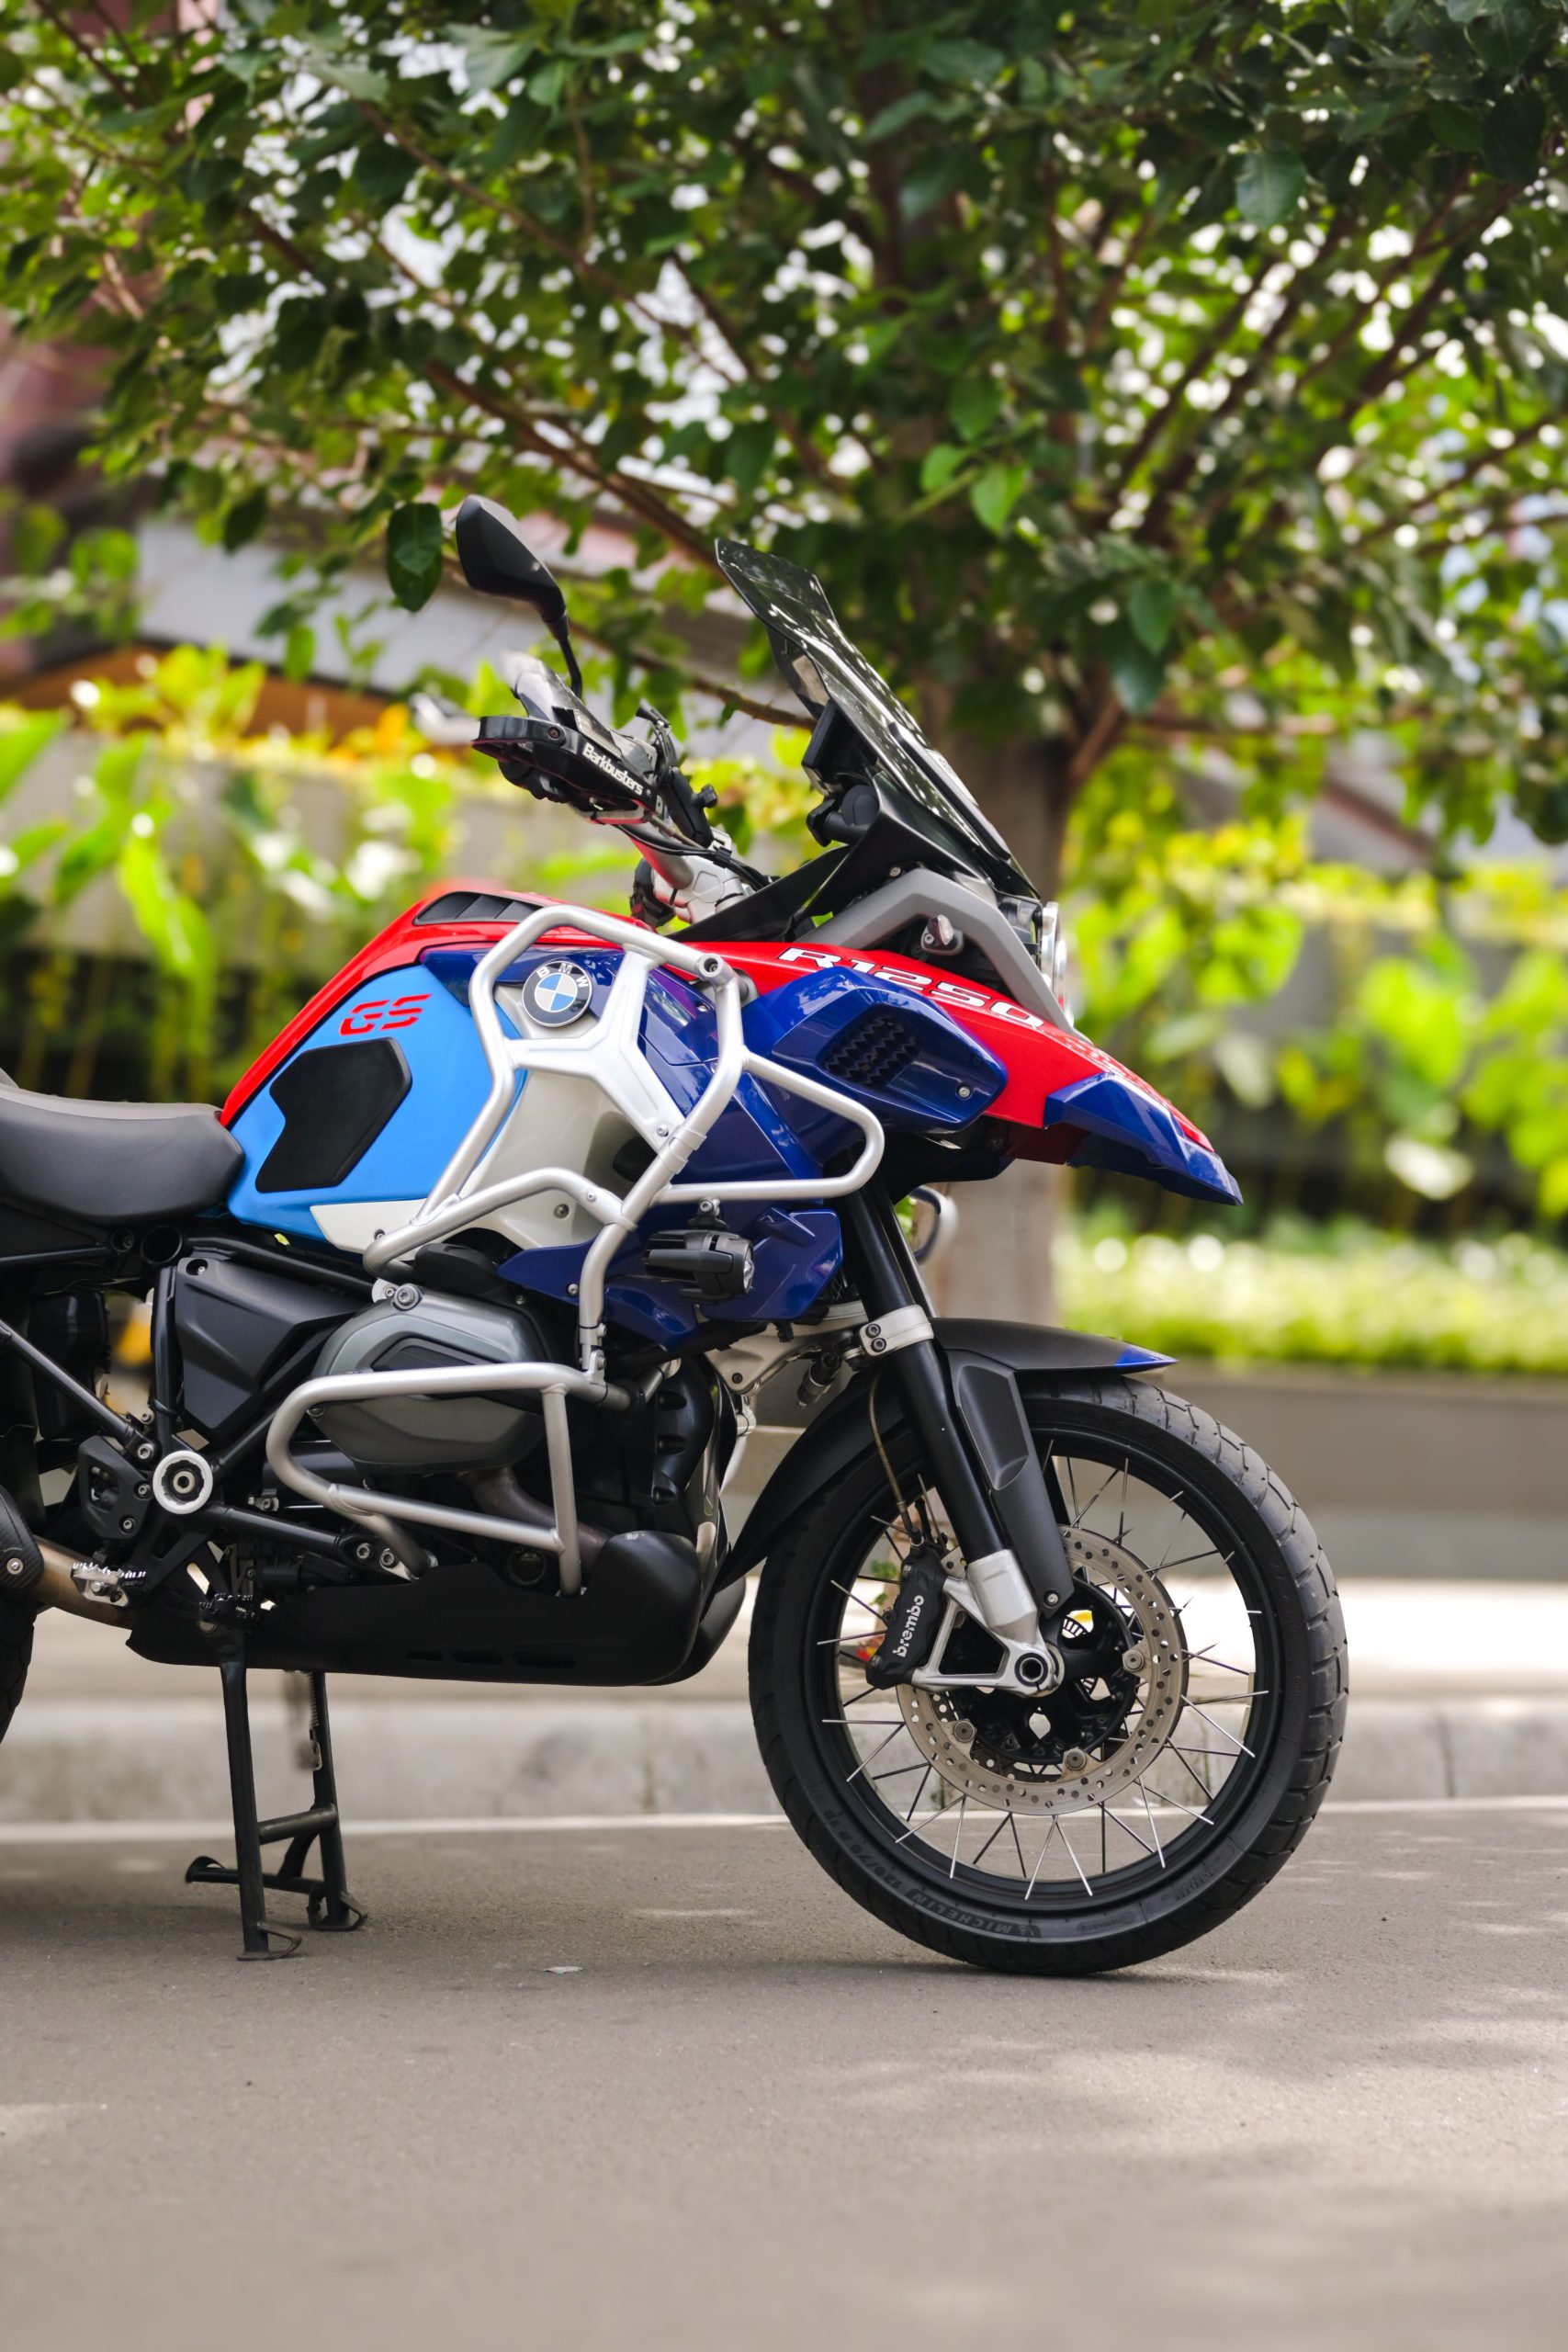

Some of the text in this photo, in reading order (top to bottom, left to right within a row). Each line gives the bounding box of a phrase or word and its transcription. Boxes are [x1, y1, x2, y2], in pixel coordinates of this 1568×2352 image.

[581, 741, 644, 797] Barkbusters
[536, 962, 589, 988] BMW
[777, 946, 1044, 1029] R1250
[338, 993, 433, 1036] GS
[893, 1595, 924, 1657] brembo
[911, 1893, 1012, 1936] MICHELIN
